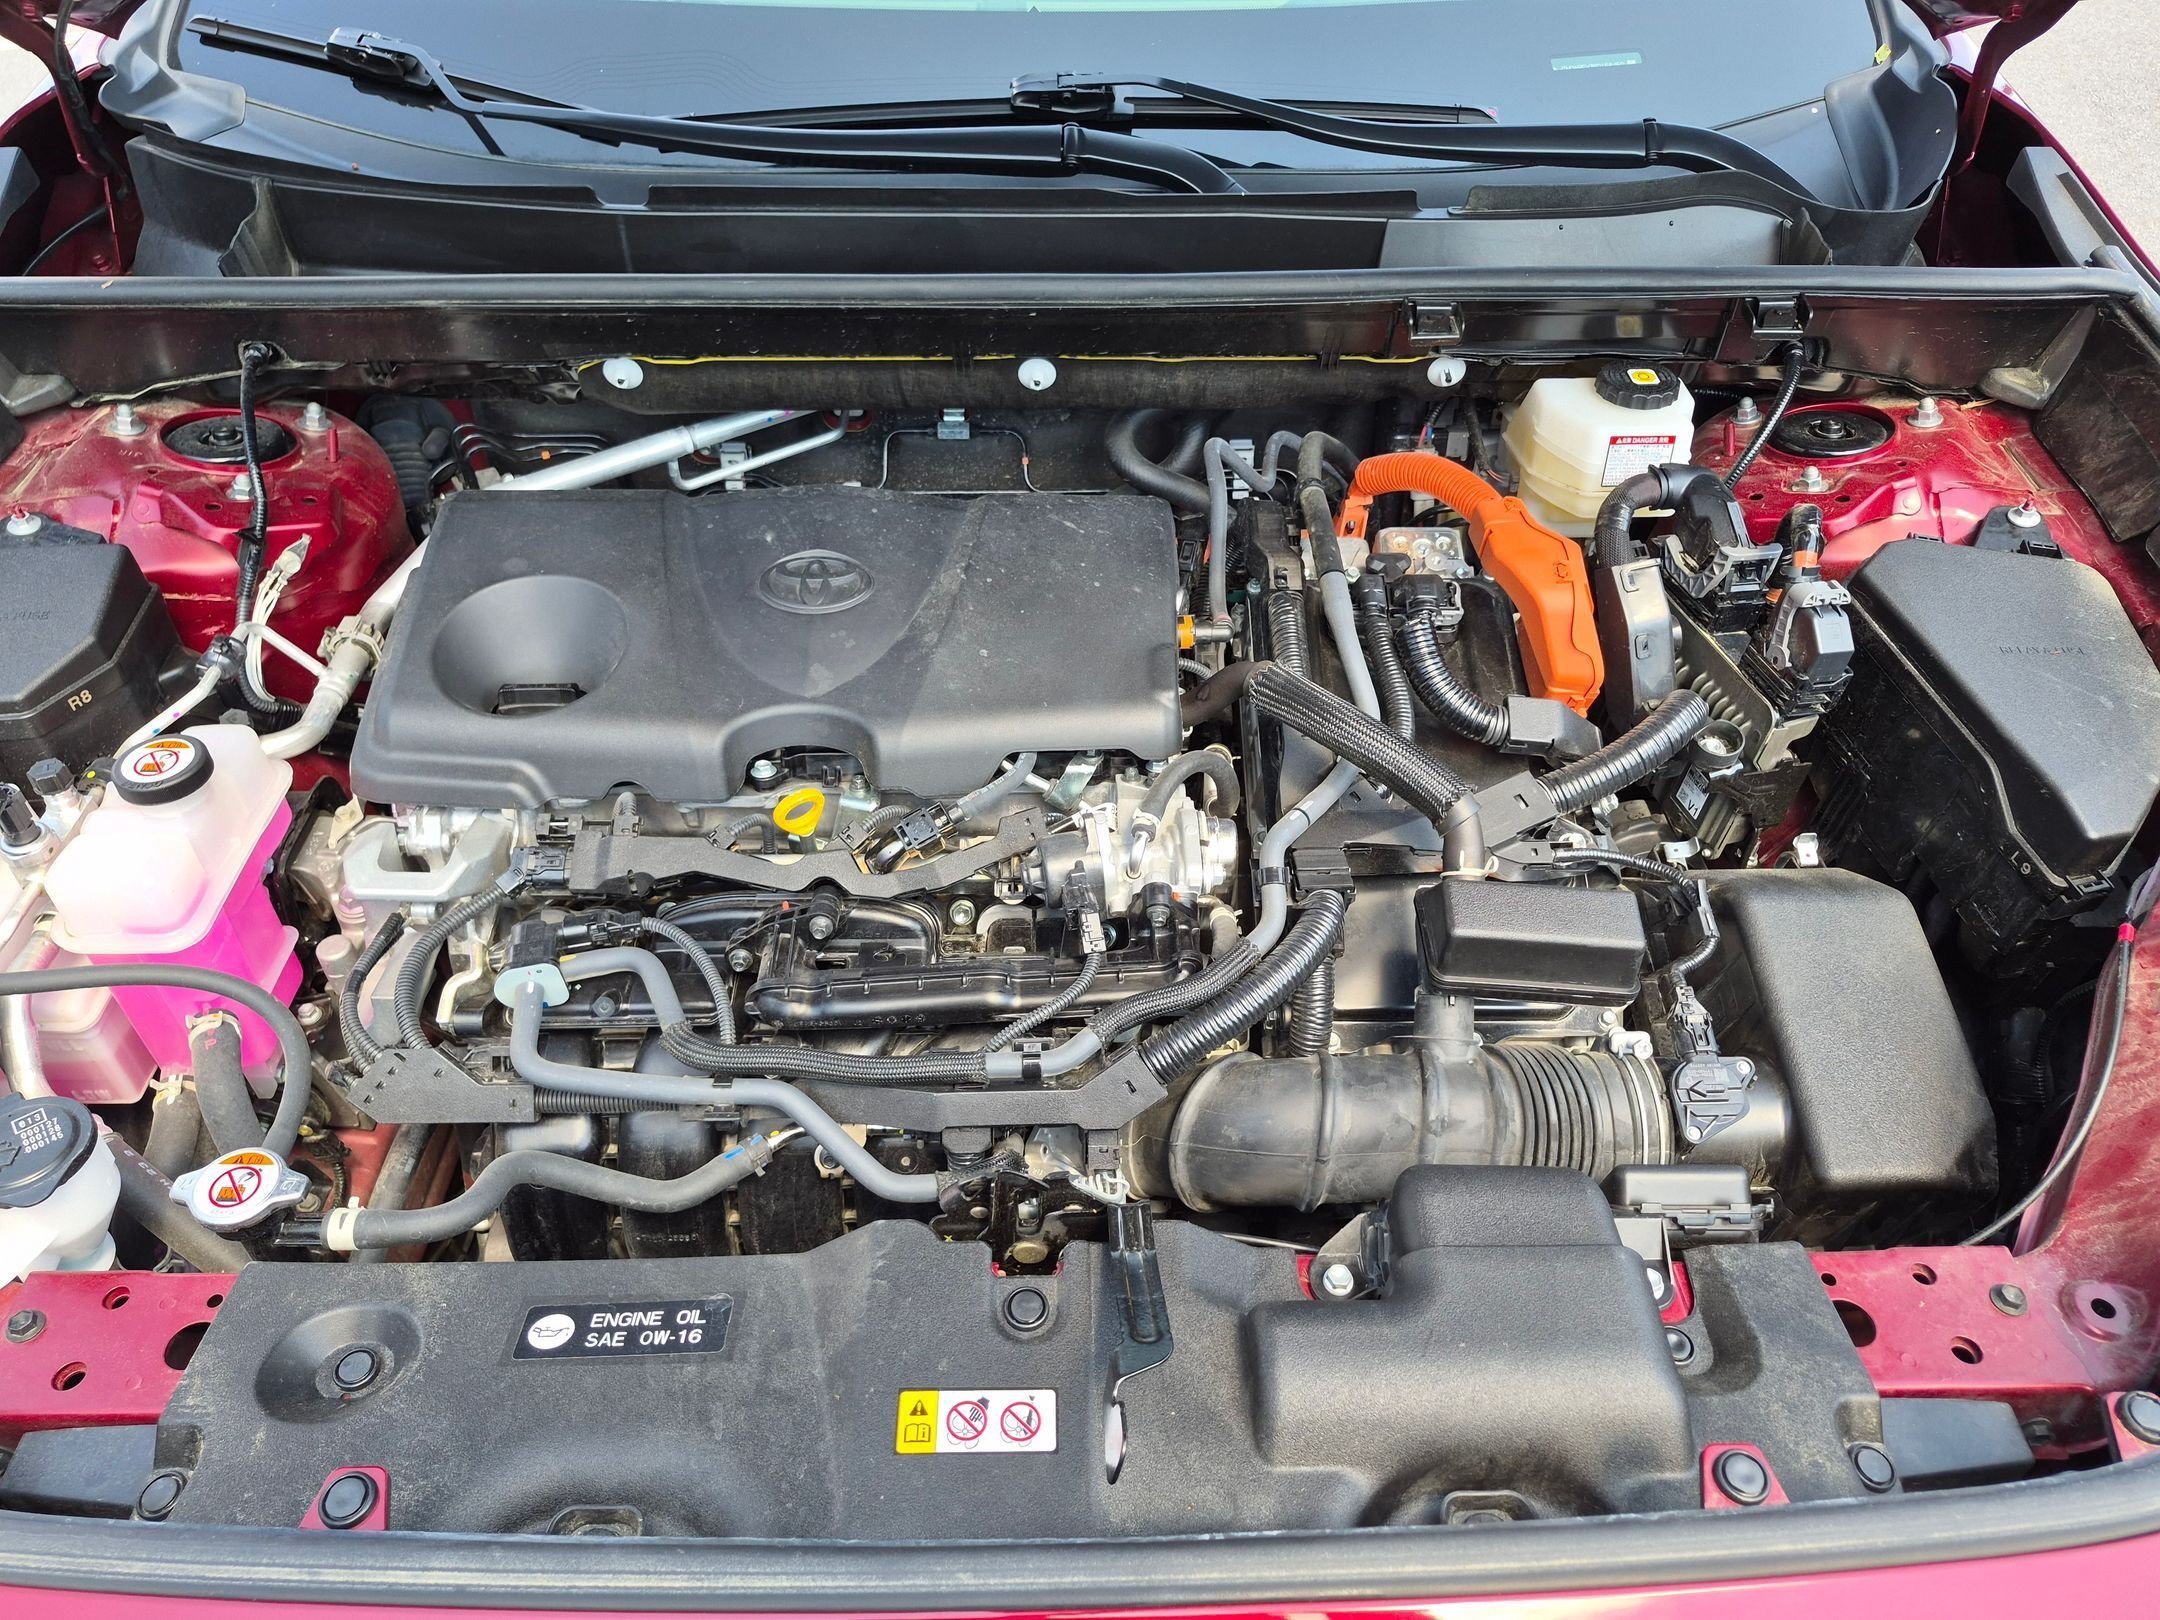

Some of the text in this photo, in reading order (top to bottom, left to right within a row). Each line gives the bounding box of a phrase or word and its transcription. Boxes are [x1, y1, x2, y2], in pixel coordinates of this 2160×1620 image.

[67, 689, 93, 712] R8
[1688, 799, 1699, 817] V1
[2010, 850, 2032, 875] L9
[20, 1116, 58, 1139] 000127
[22, 1124, 61, 1146] 000128
[589, 1309, 707, 1328] ENGINE OIL
[584, 1331, 628, 1348] SAE
